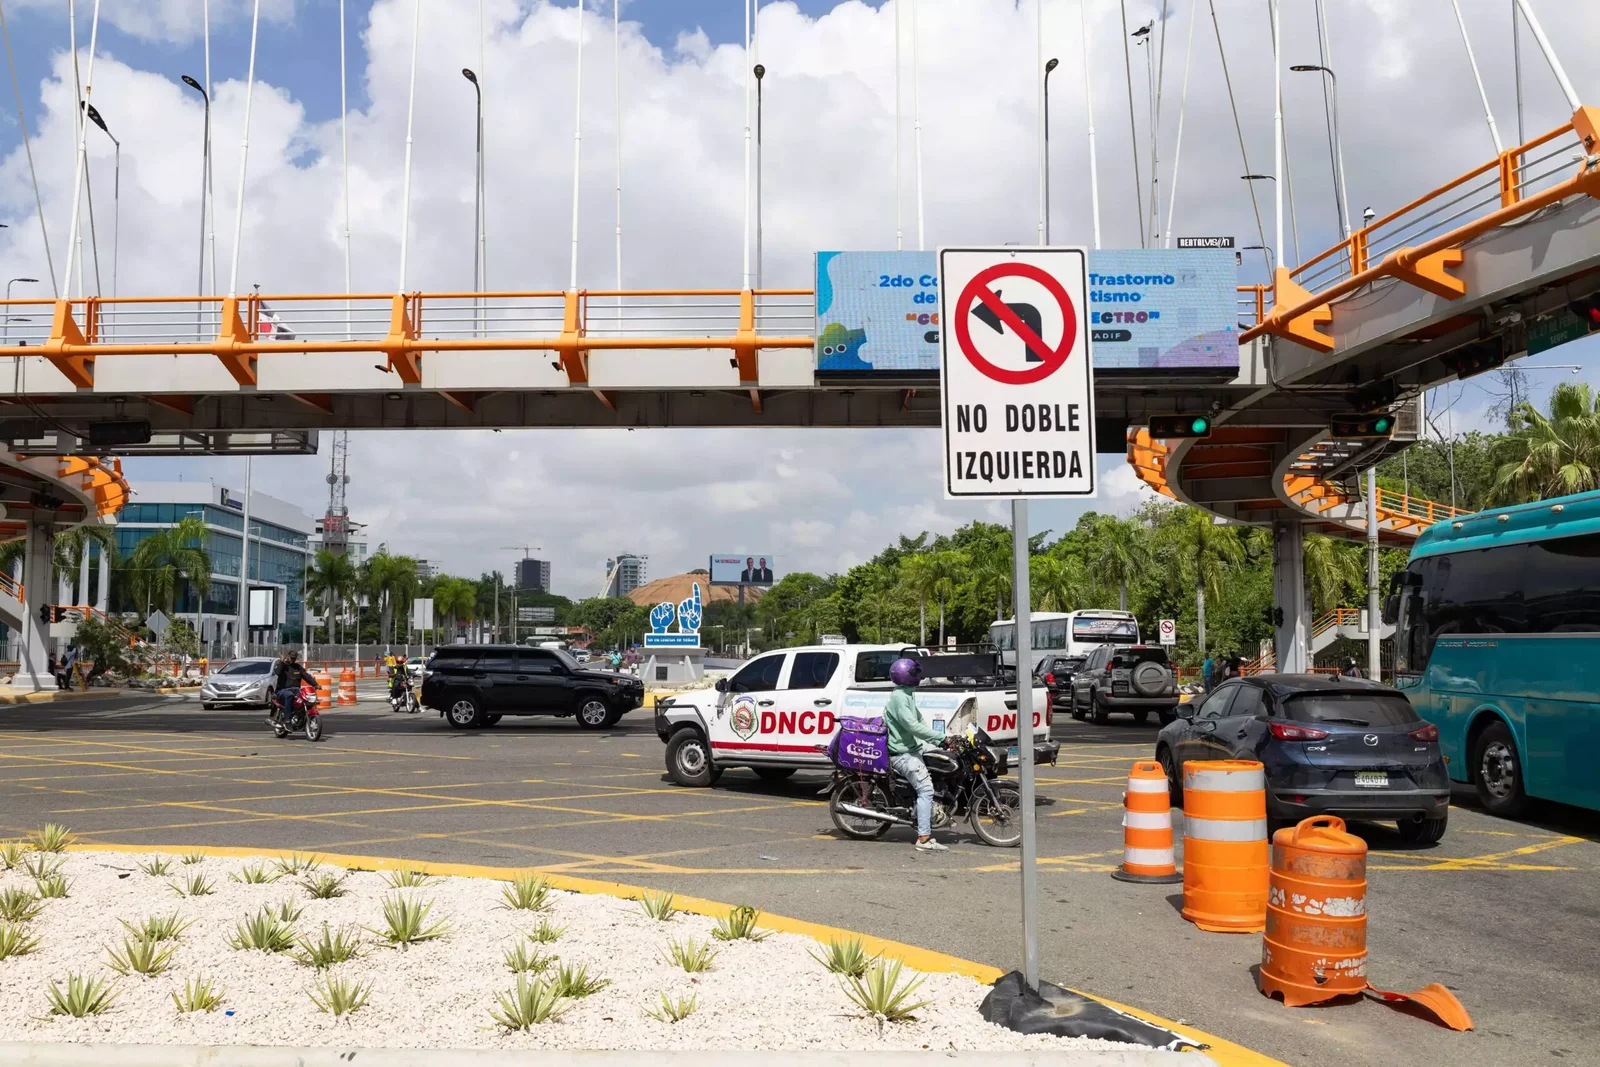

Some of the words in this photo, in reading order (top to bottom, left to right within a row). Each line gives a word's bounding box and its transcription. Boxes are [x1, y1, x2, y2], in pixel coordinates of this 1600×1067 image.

[879, 274, 914, 288] 2do
[1089, 273, 1175, 286] Trastorno
[956, 403, 988, 433] NO
[1005, 403, 1080, 433] DOBLE
[956, 450, 1083, 484] IZQUIERDA
[760, 711, 835, 735] DNCD
[986, 711, 1041, 732] DND
[847, 743, 882, 759] todo
